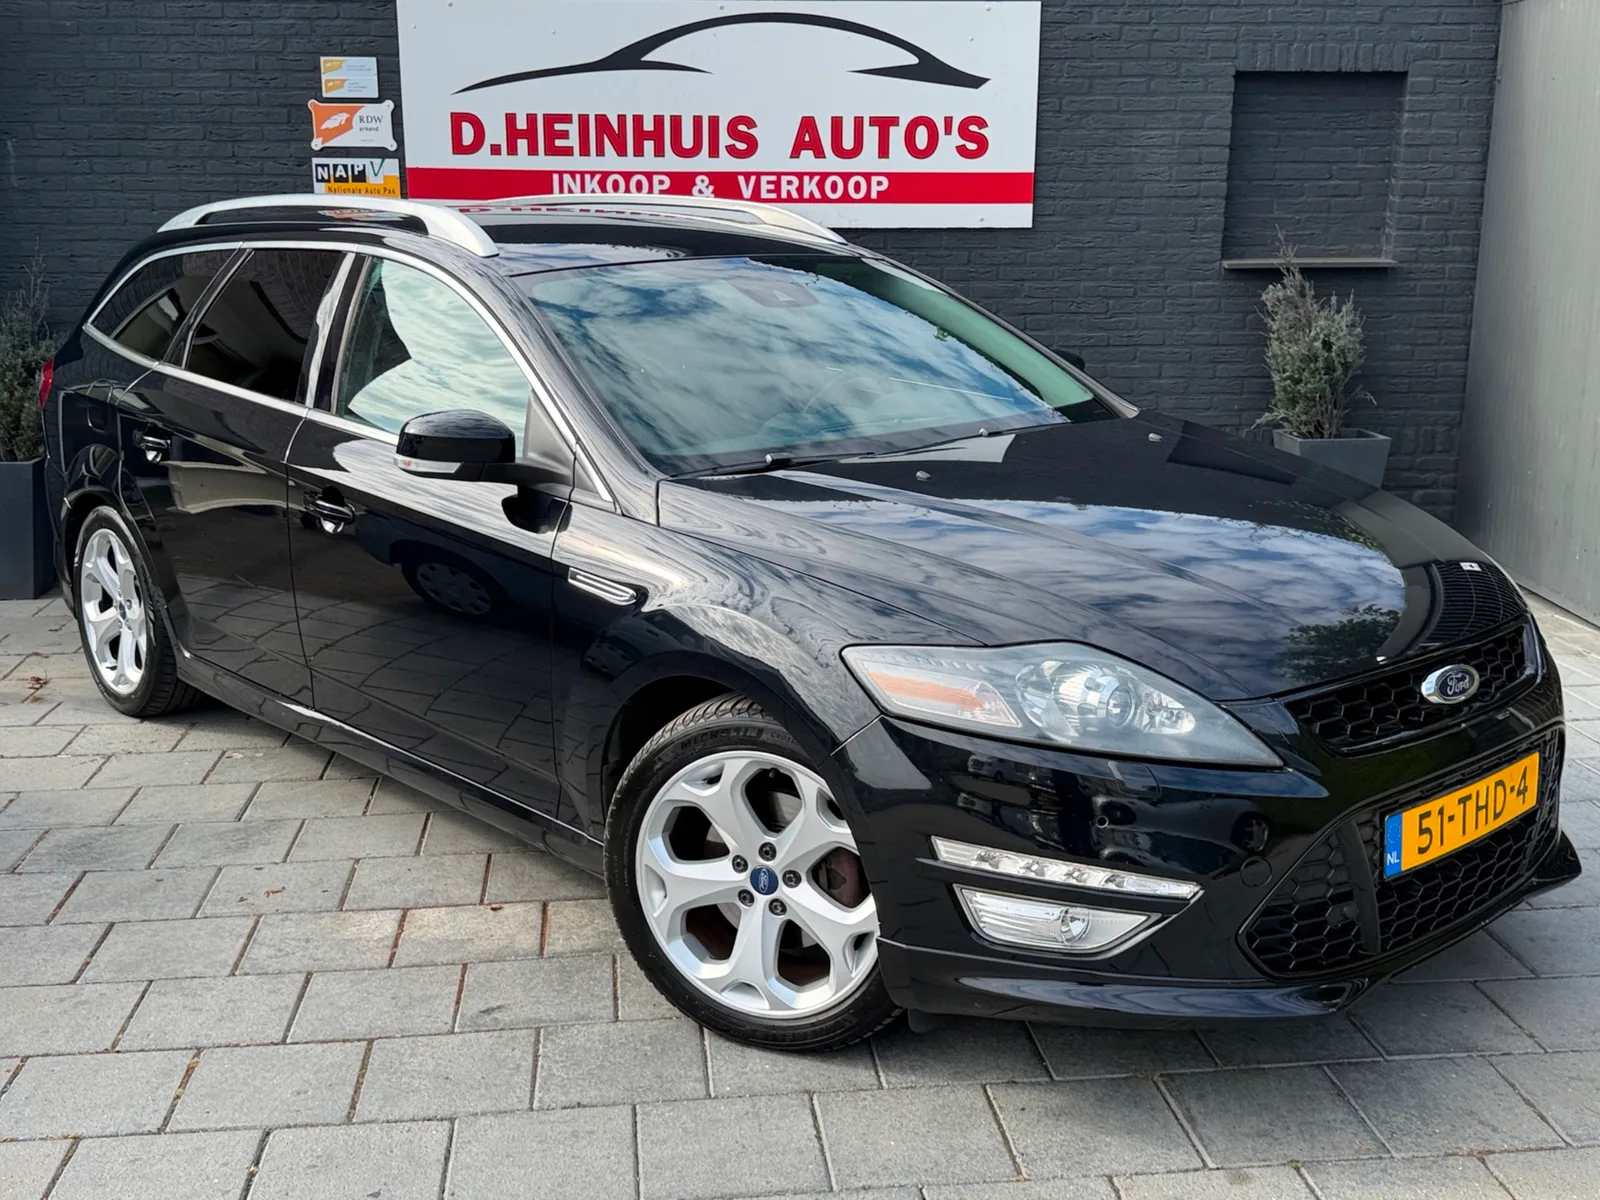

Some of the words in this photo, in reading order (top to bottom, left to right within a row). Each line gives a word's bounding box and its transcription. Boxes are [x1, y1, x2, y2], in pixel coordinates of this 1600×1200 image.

[359, 115, 384, 124] RDW
[450, 112, 759, 159] D.HEINHUIS
[789, 115, 990, 160] AUTO'S
[327, 186, 362, 194] Nationale
[365, 187, 381, 195] Auto
[383, 187, 396, 195] Pas
[552, 173, 671, 195] INKOOP
[691, 175, 715, 197] &
[737, 175, 890, 200] VERKOOP
[1447, 671, 1470, 695] Ford
[1417, 766, 1529, 855] 51-THD-4
[1386, 850, 1400, 866] NL
